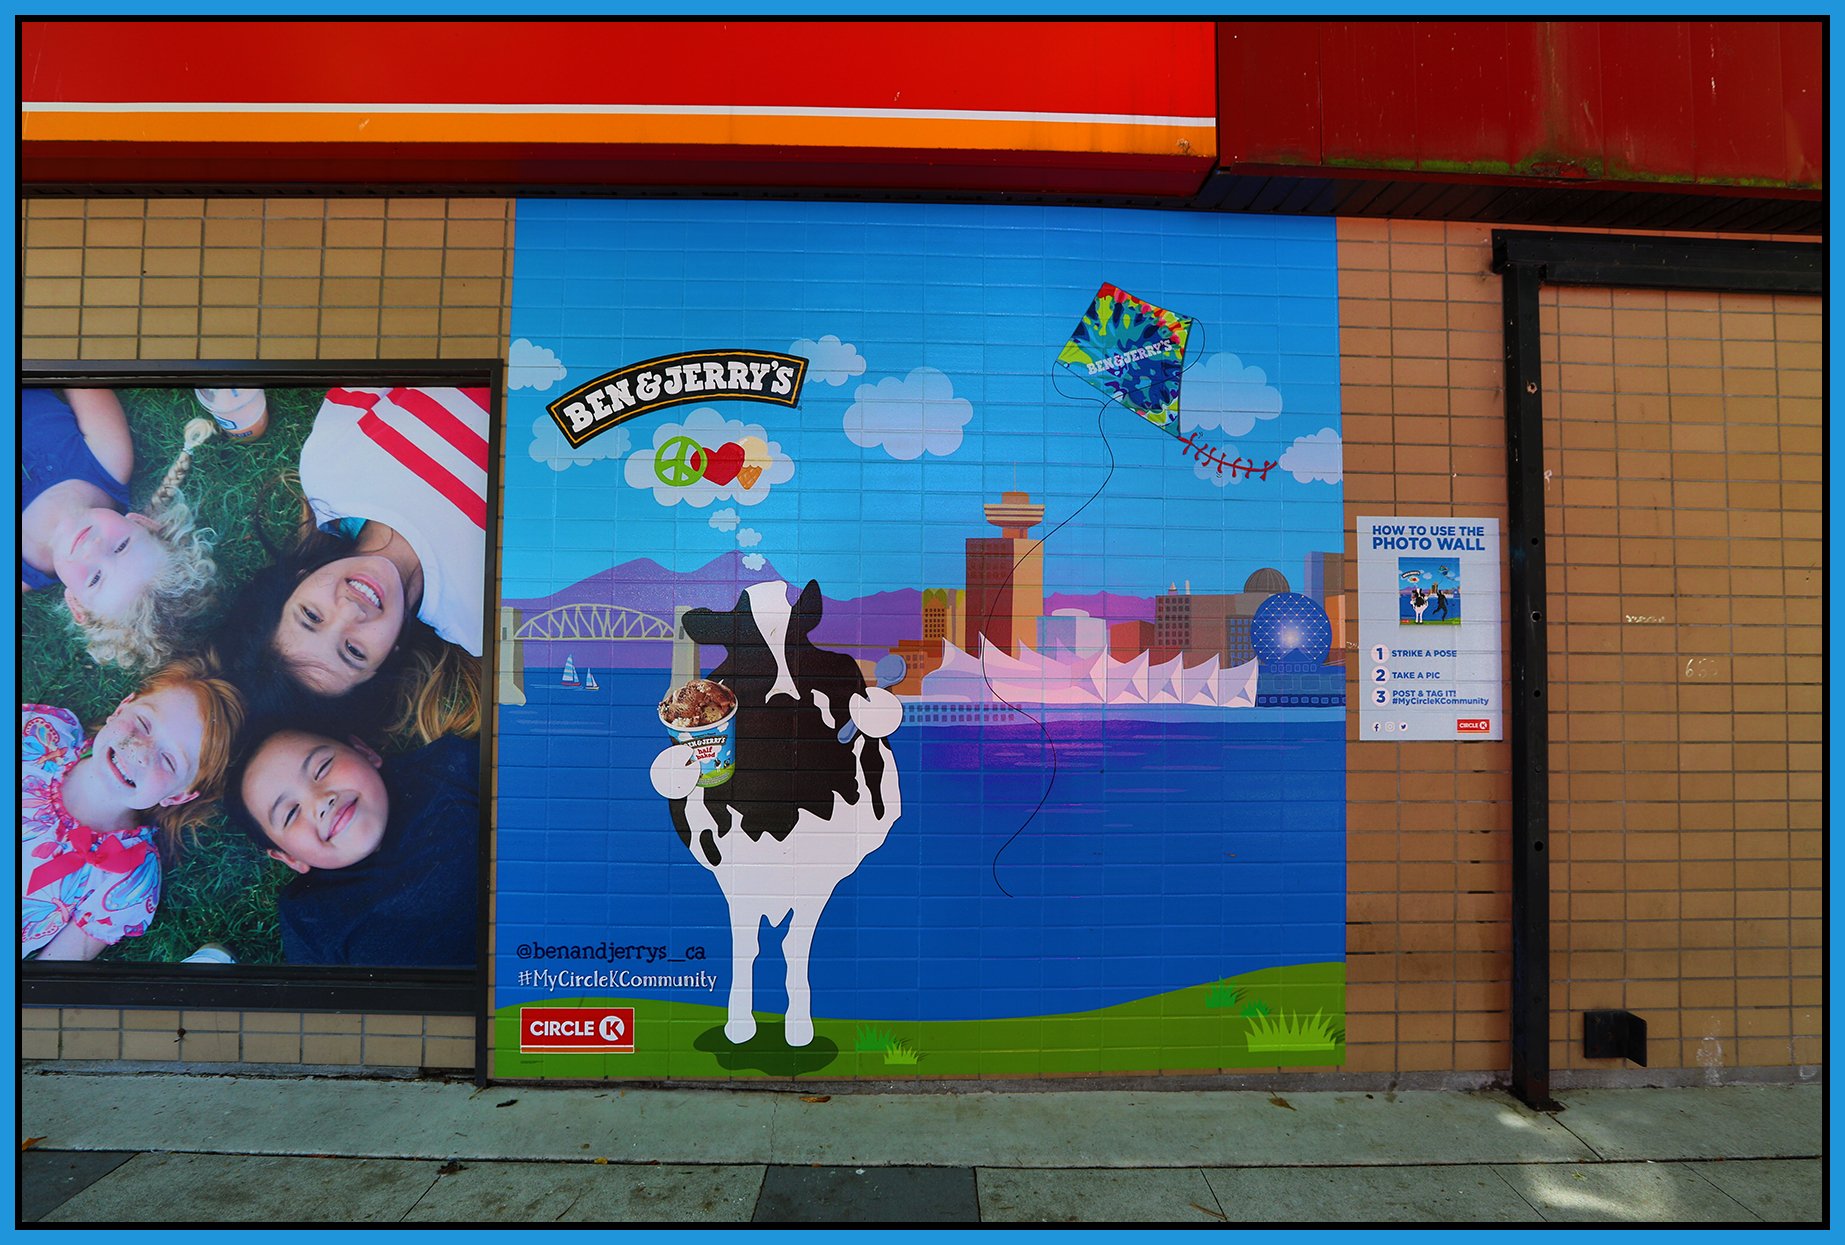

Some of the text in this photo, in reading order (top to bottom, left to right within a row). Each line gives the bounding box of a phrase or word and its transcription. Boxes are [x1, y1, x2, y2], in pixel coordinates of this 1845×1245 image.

[563, 360, 795, 433] BEN & JERRY'S
[1372, 525, 1485, 537] HOW TO USE THE
[1372, 536, 1485, 551] PHOTO WALL
[1376, 647, 1458, 660] 1 STRIKE A POSE
[1375, 668, 1441, 682] 2 TAKE A PIC
[1375, 690, 1386, 703] 3
[1392, 697, 1489, 706] #MyCircleKCommunity
[696, 752, 716, 760] baked
[697, 746, 713, 754] half
[518, 969, 718, 992] #MyCircleKCommunity
[529, 1018, 623, 1040] CIRCLE K
